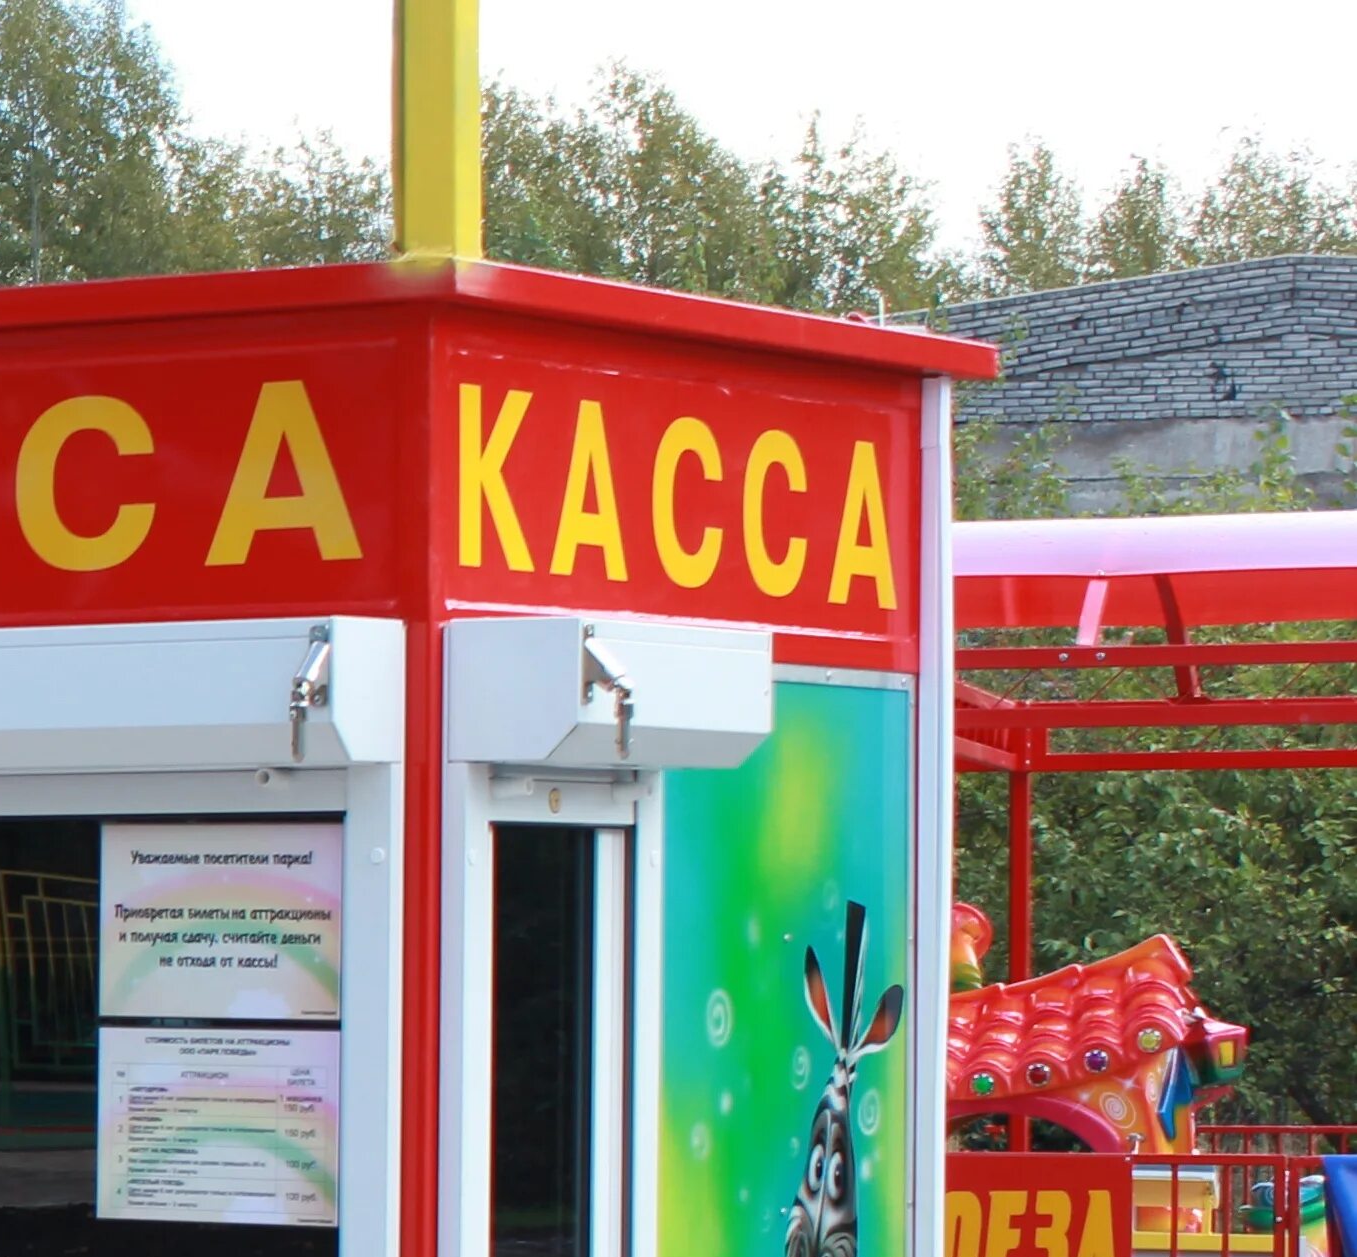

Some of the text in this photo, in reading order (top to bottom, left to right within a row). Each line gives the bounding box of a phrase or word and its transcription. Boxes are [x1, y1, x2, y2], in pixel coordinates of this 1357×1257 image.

[458, 383, 898, 610] КАССА
[131, 850, 313, 868] Уважаемые посетители парка!
[114, 904, 184, 922] Приобретая
[231, 909, 246, 920] на
[250, 908, 332, 923] аттракционы
[119, 933, 127, 943] и
[130, 932, 178, 946] получая
[222, 931, 277, 944] считайте
[280, 933, 321, 945] деньги
[159, 954, 279, 968] не отходя от кассы!
